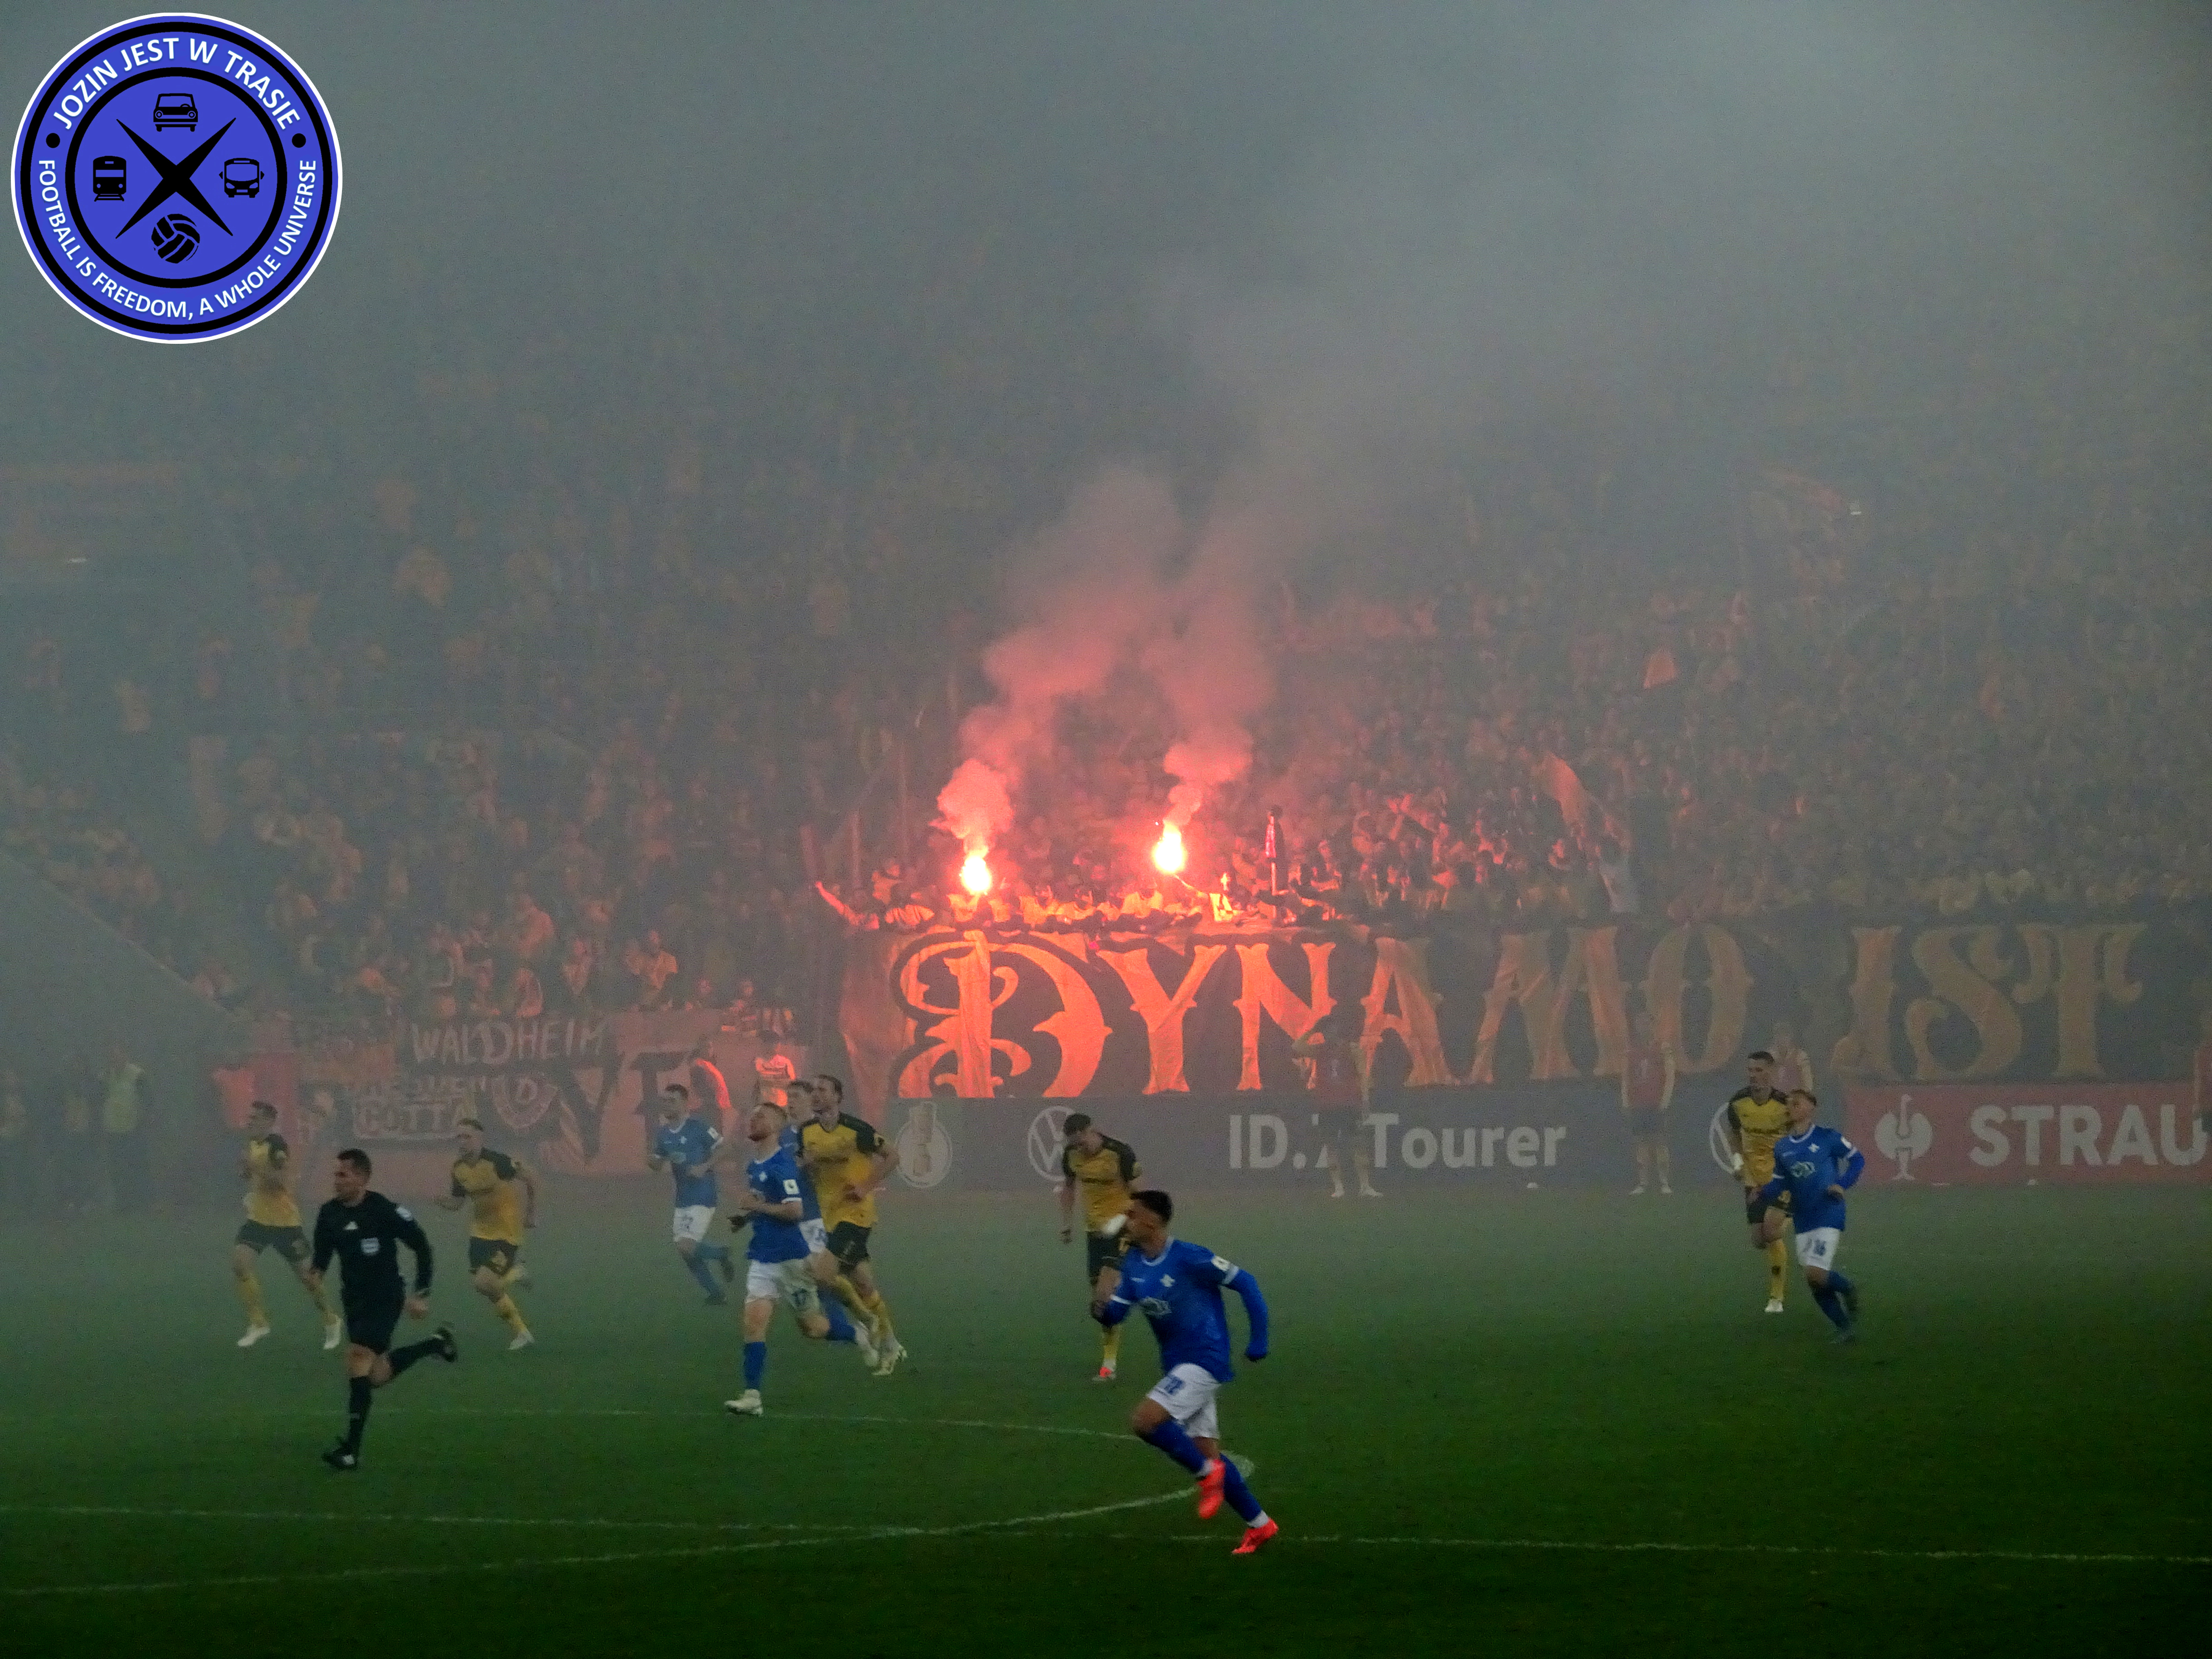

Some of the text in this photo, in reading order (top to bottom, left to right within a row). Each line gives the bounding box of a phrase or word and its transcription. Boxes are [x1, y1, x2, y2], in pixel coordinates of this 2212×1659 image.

[898, 923, 2147, 1098] DYNAMO IST
[410, 1017, 607, 1066] WALDHEIM
[1364, 1113, 1567, 1169] Tourer
[1969, 1104, 2208, 1167] STRAU
